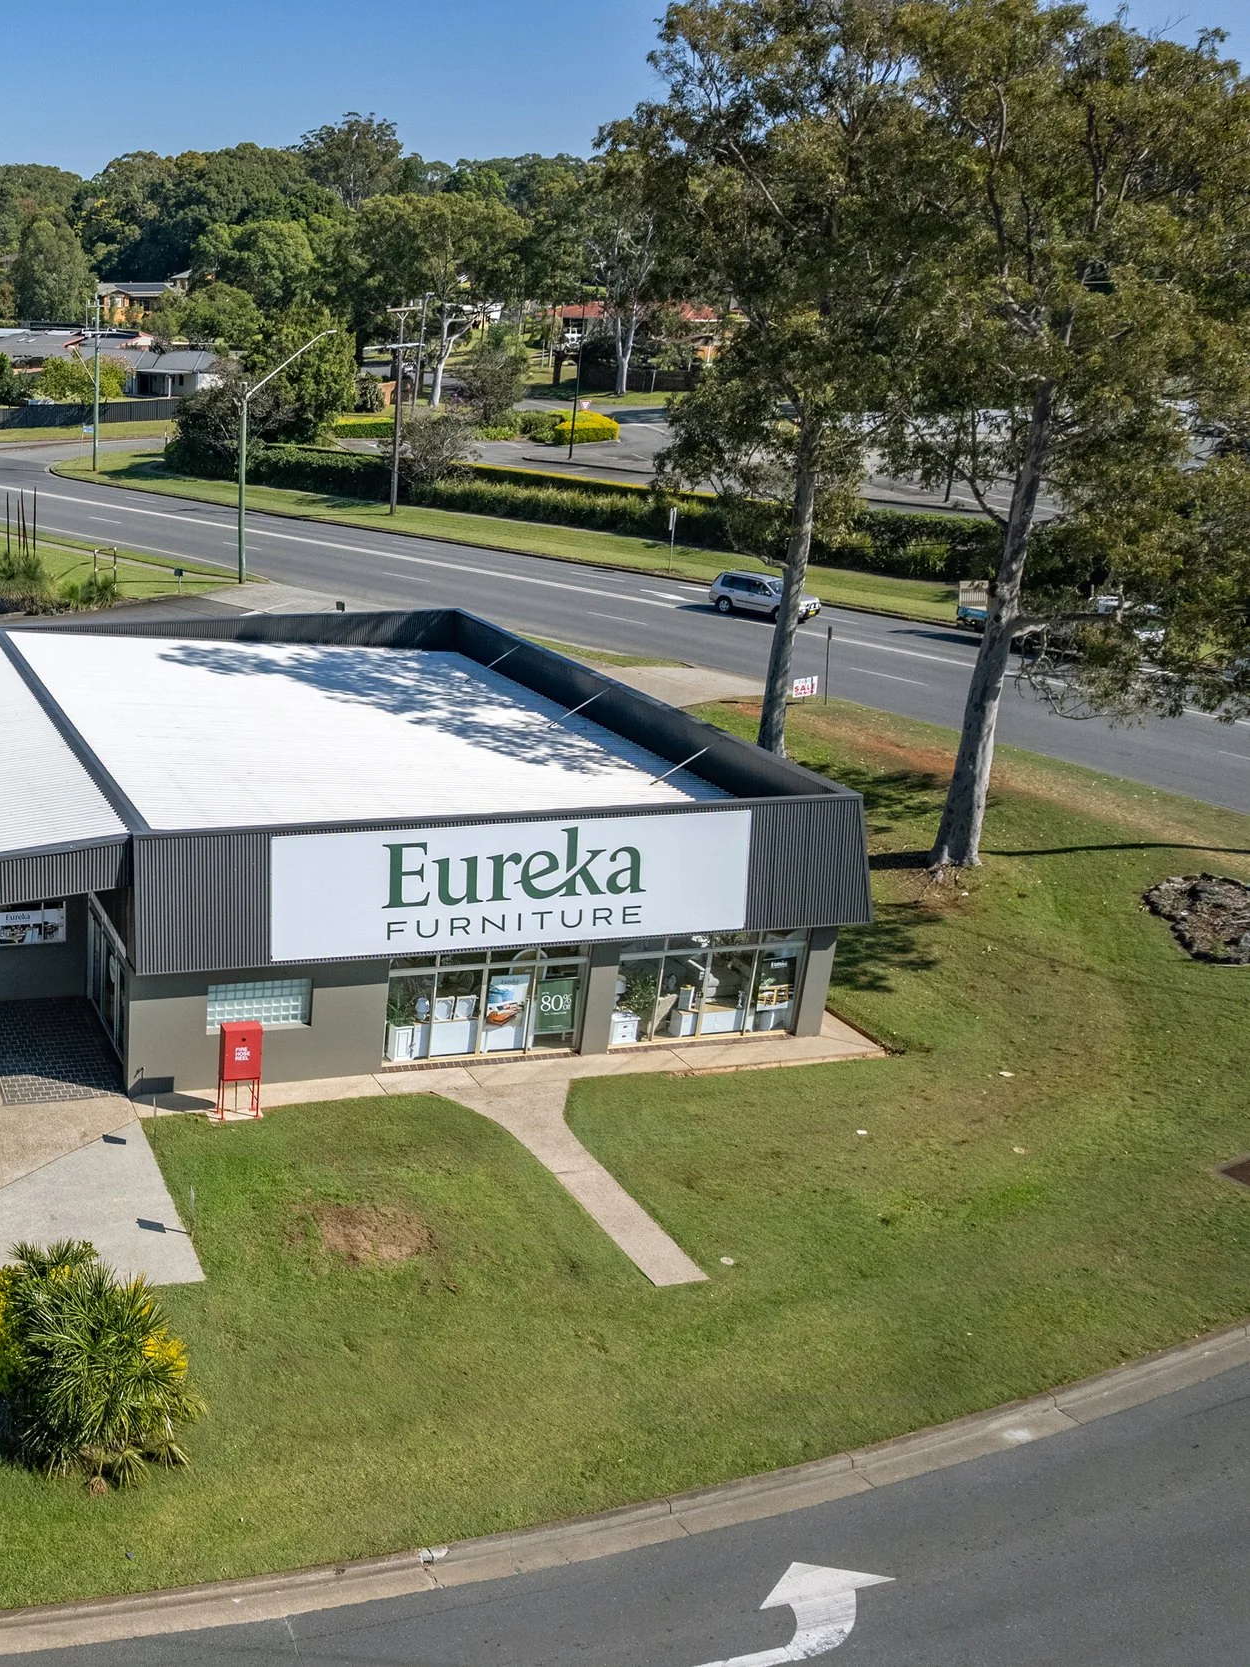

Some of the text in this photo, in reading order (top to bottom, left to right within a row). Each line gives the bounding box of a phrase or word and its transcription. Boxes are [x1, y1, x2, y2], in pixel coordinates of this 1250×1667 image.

[794, 683, 816, 692] SALE
[382, 826, 647, 909] Eureka
[5, 912, 31, 921] Eureka
[386, 905, 643, 941] FURNITURE
